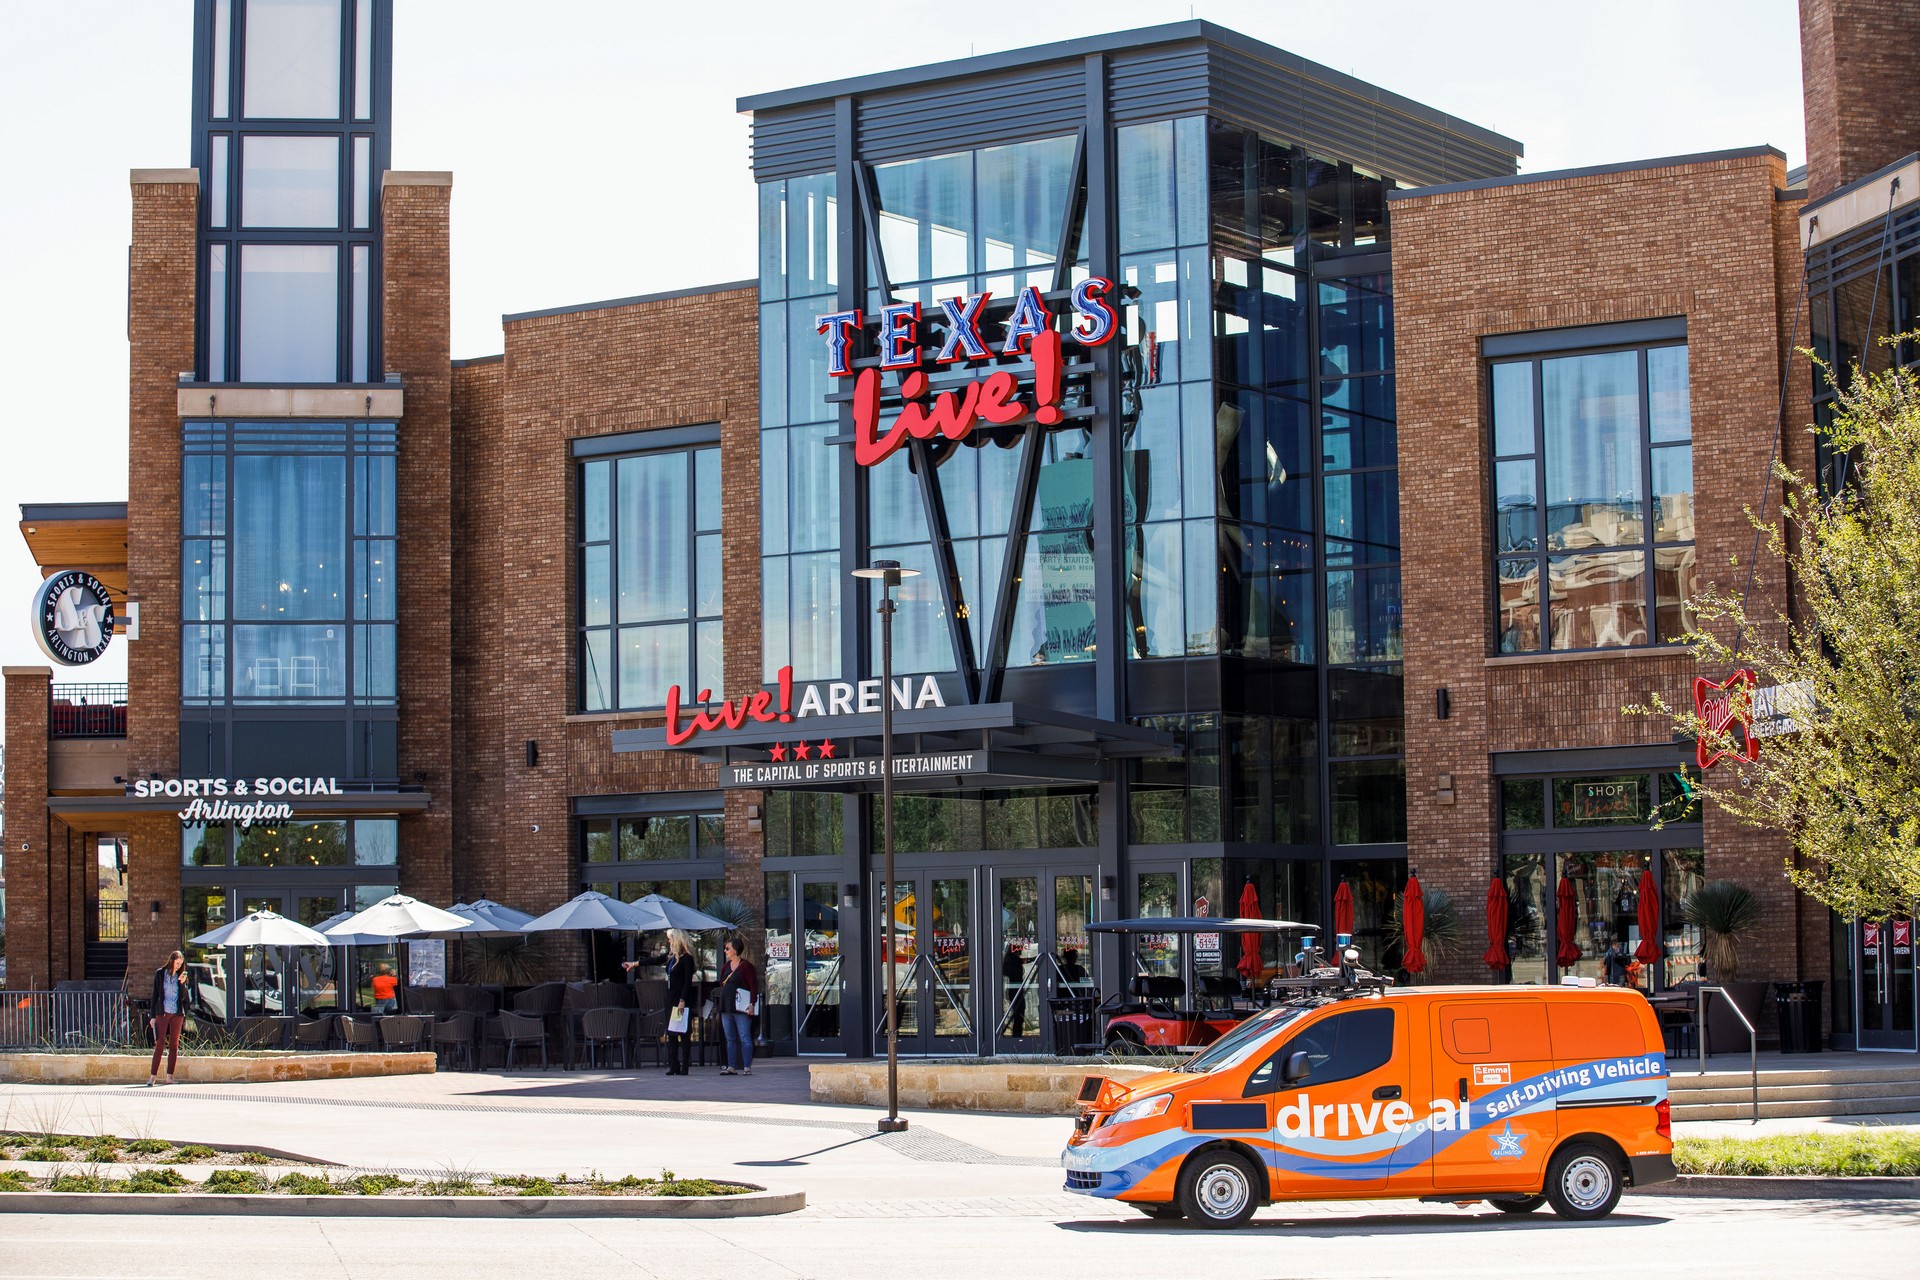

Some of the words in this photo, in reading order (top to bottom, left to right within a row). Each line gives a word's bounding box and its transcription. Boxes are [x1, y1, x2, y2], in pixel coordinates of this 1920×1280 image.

[816, 276, 1118, 377] TEXAS
[853, 330, 1064, 466] Live!
[48, 574, 74, 607] SPORTS
[78, 573, 84, 584] &
[87, 576, 112, 608] SOCIAL
[94, 627, 113, 656] TEXAS
[665, 665, 794, 746] Live!
[797, 675, 946, 718] ARENA
[733, 768, 753, 783] THE
[757, 765, 802, 781] CAPITAL
[805, 764, 819, 779] OF
[823, 761, 865, 778] SPORTS
[869, 760, 876, 775] &
[880, 754, 973, 774] ETERTAINMENT
[134, 778, 228, 797] SPORTS
[234, 779, 249, 796] &
[254, 777, 343, 796] SOCIAL
[1588, 785, 1624, 797] SHOP
[178, 798, 293, 828] Arlington
[1584, 793, 1630, 817] Live!
[937, 938, 966, 947] TEXAS
[1864, 947, 1877, 955] TAVER
[1482, 1066, 1507, 1074] Emma
[1486, 1069, 1592, 1118] Self-Driving
[1593, 1058, 1661, 1079] Vehicle
